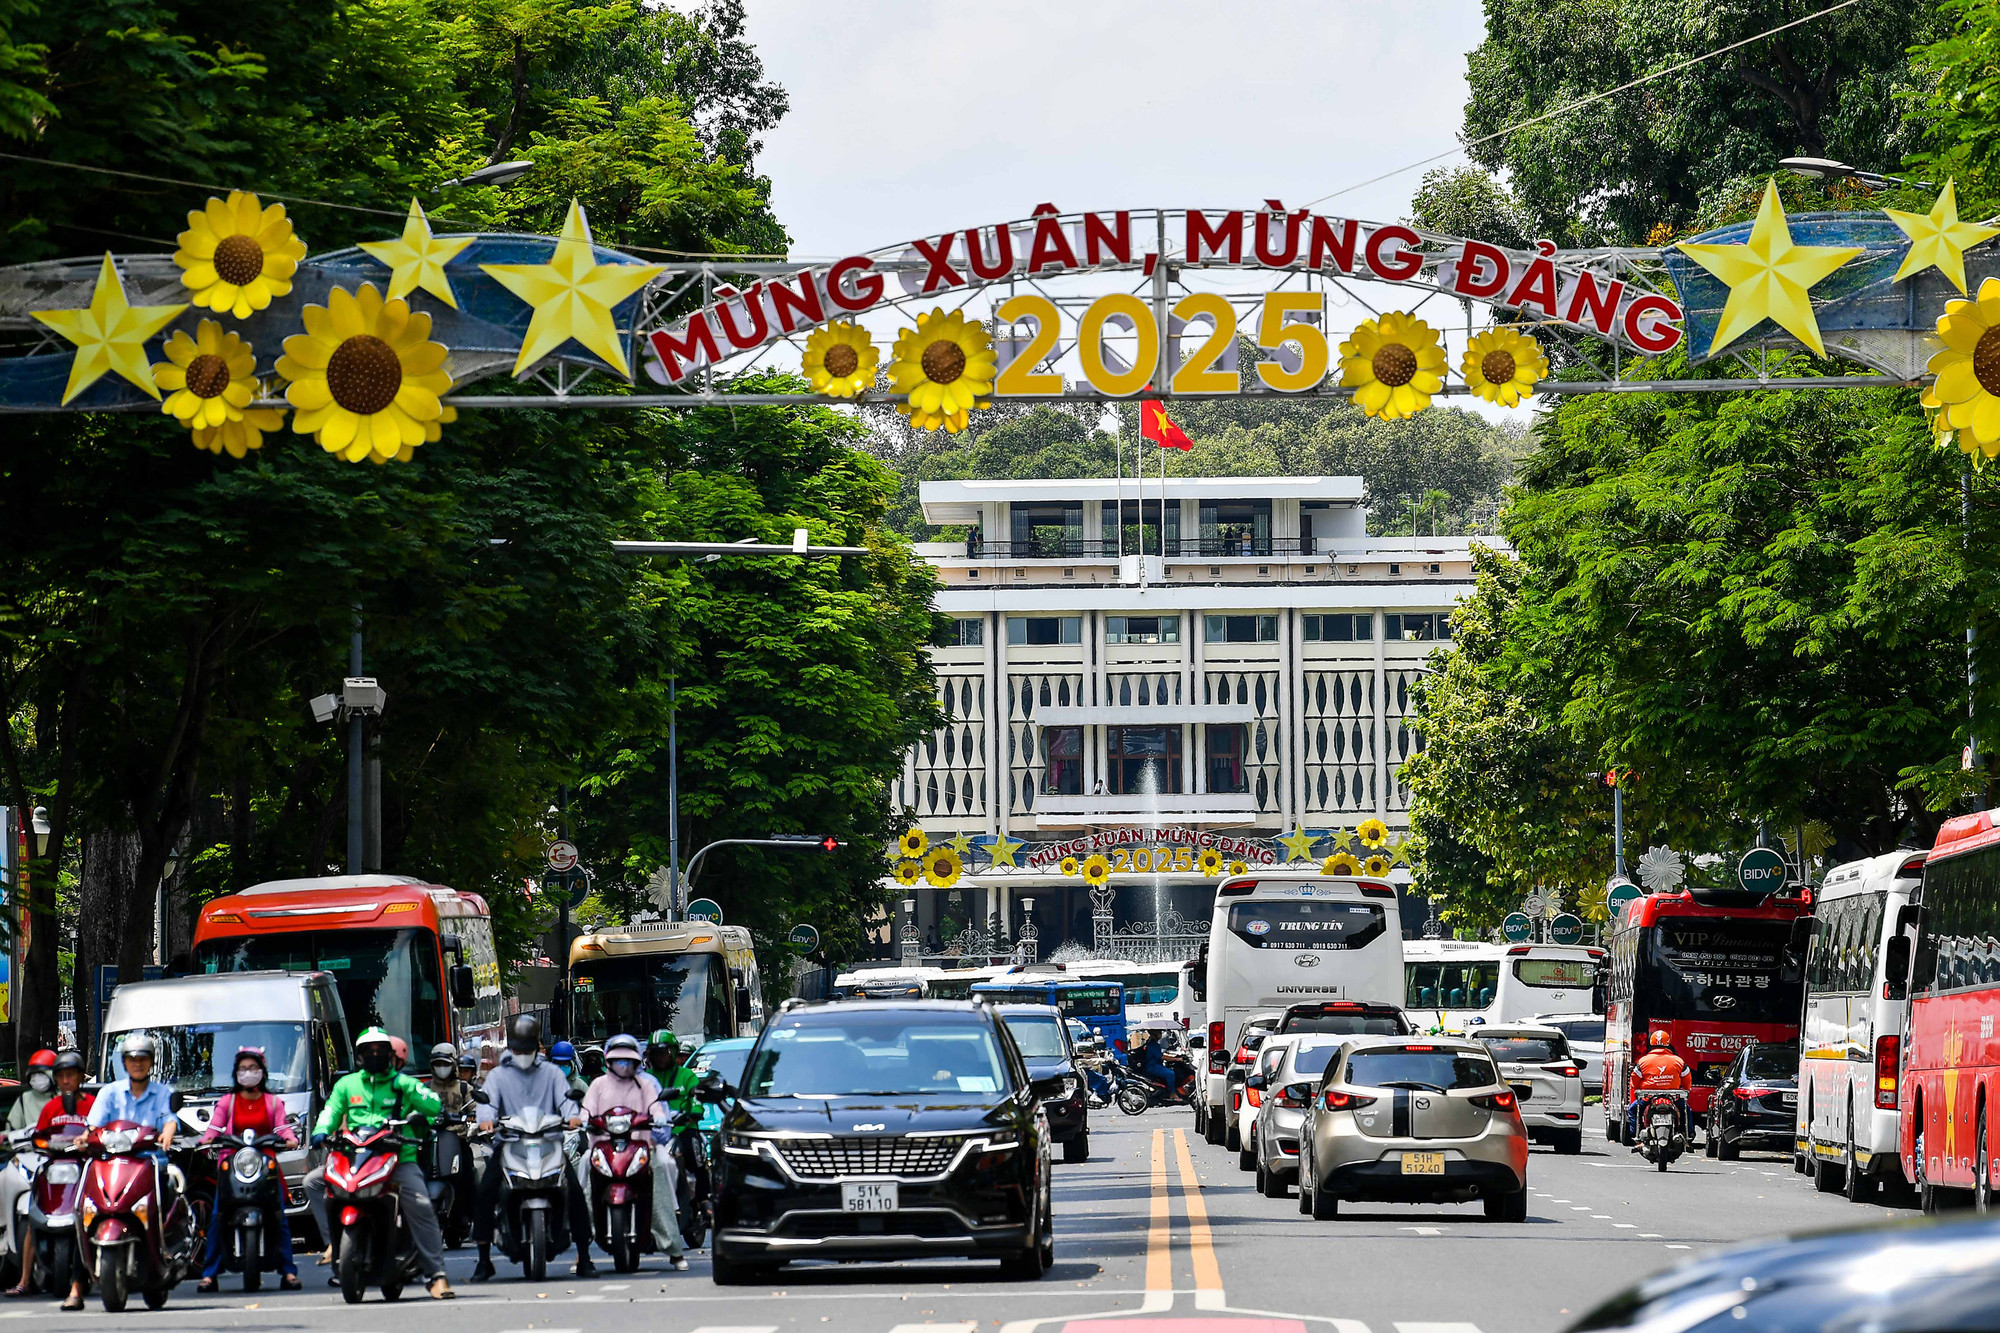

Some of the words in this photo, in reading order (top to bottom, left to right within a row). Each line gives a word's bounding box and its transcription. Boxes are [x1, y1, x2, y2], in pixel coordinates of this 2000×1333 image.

[648, 256, 885, 382] MỪNG
[912, 202, 1158, 294] XUÂN,
[1185, 199, 1425, 282] MỪNG
[1453, 238, 1684, 354] ĐẢNG
[995, 291, 1329, 397] 2025
[1029, 839, 1086, 868] MỪNG
[1155, 826, 1214, 847] MỪNG
[1220, 837, 1276, 865] ĐẢNG
[1112, 847, 1193, 873] 2025
[1743, 867, 1772, 880] BIDV
[1278, 921, 1320, 931] TRUNG
[1321, 919, 1344, 931] TÍN
[1505, 924, 1523, 934] BIDV
[1553, 927, 1572, 937] BIDV
[1674, 932, 1708, 945] VIP
[1681, 972, 1771, 989] 뉴하나관광
[1276, 985, 1338, 994] UNIVERSE
[1686, 1035, 1710, 1049] 50F
[1413, 1153, 1433, 1163] 51H
[1406, 1163, 1440, 1174] 512.40
[858, 1184, 882, 1197] 51K
